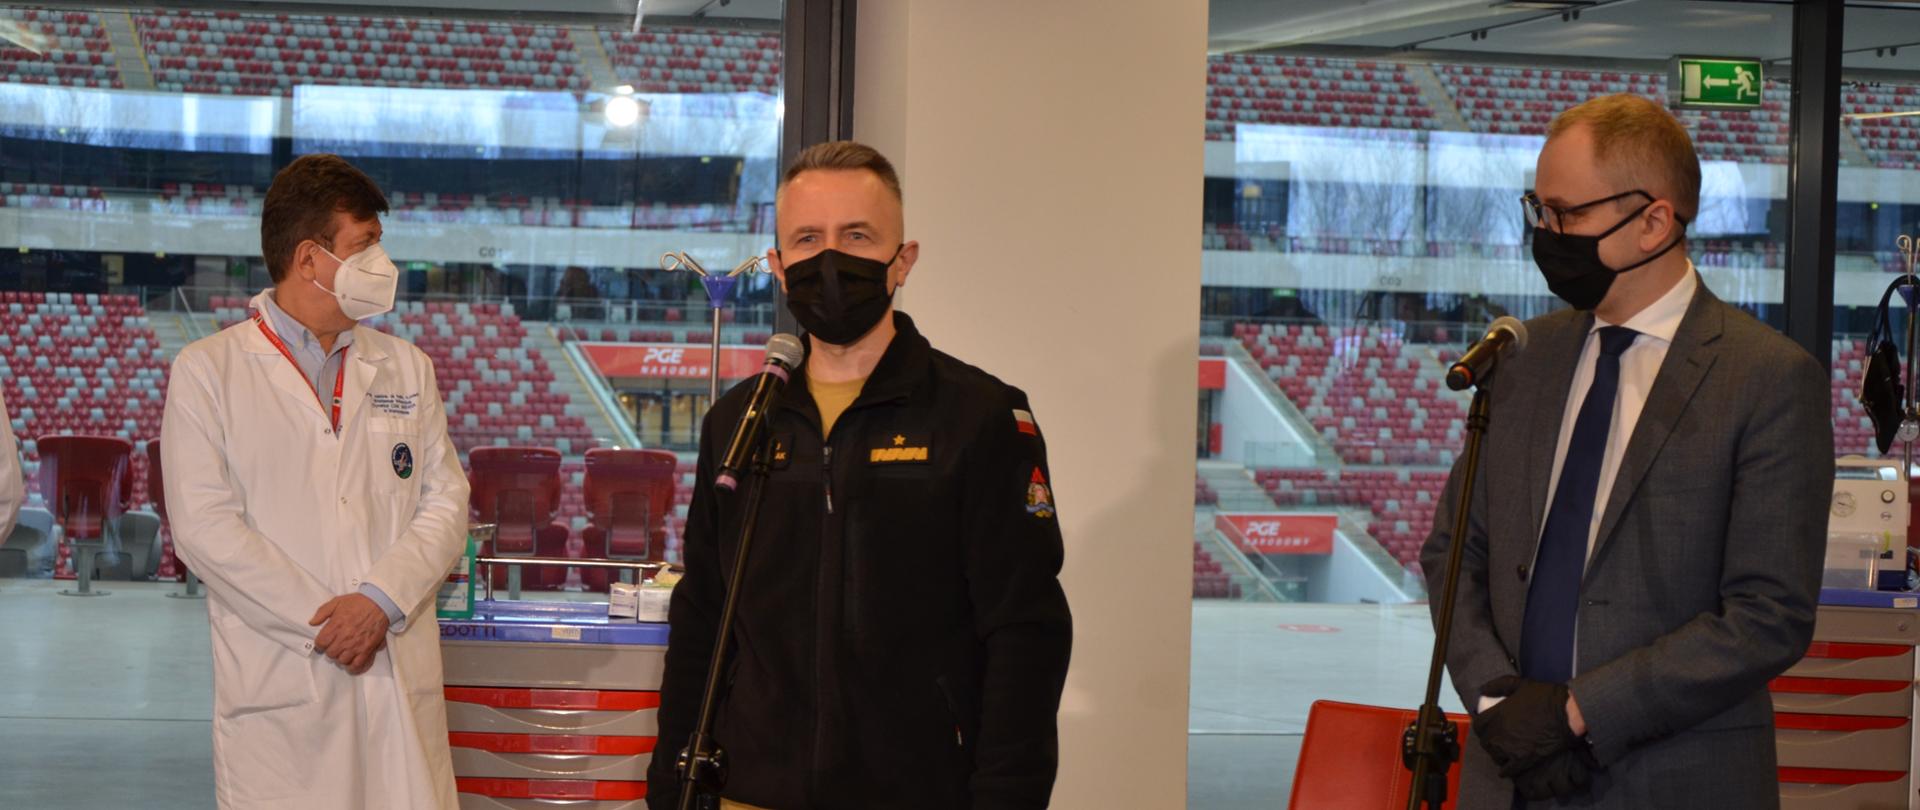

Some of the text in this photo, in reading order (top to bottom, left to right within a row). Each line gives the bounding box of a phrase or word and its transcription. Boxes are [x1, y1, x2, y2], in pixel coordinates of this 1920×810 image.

[643, 348, 686, 364] PGE
[640, 365, 709, 376] NARODOW
[1246, 521, 1281, 536] PGE
